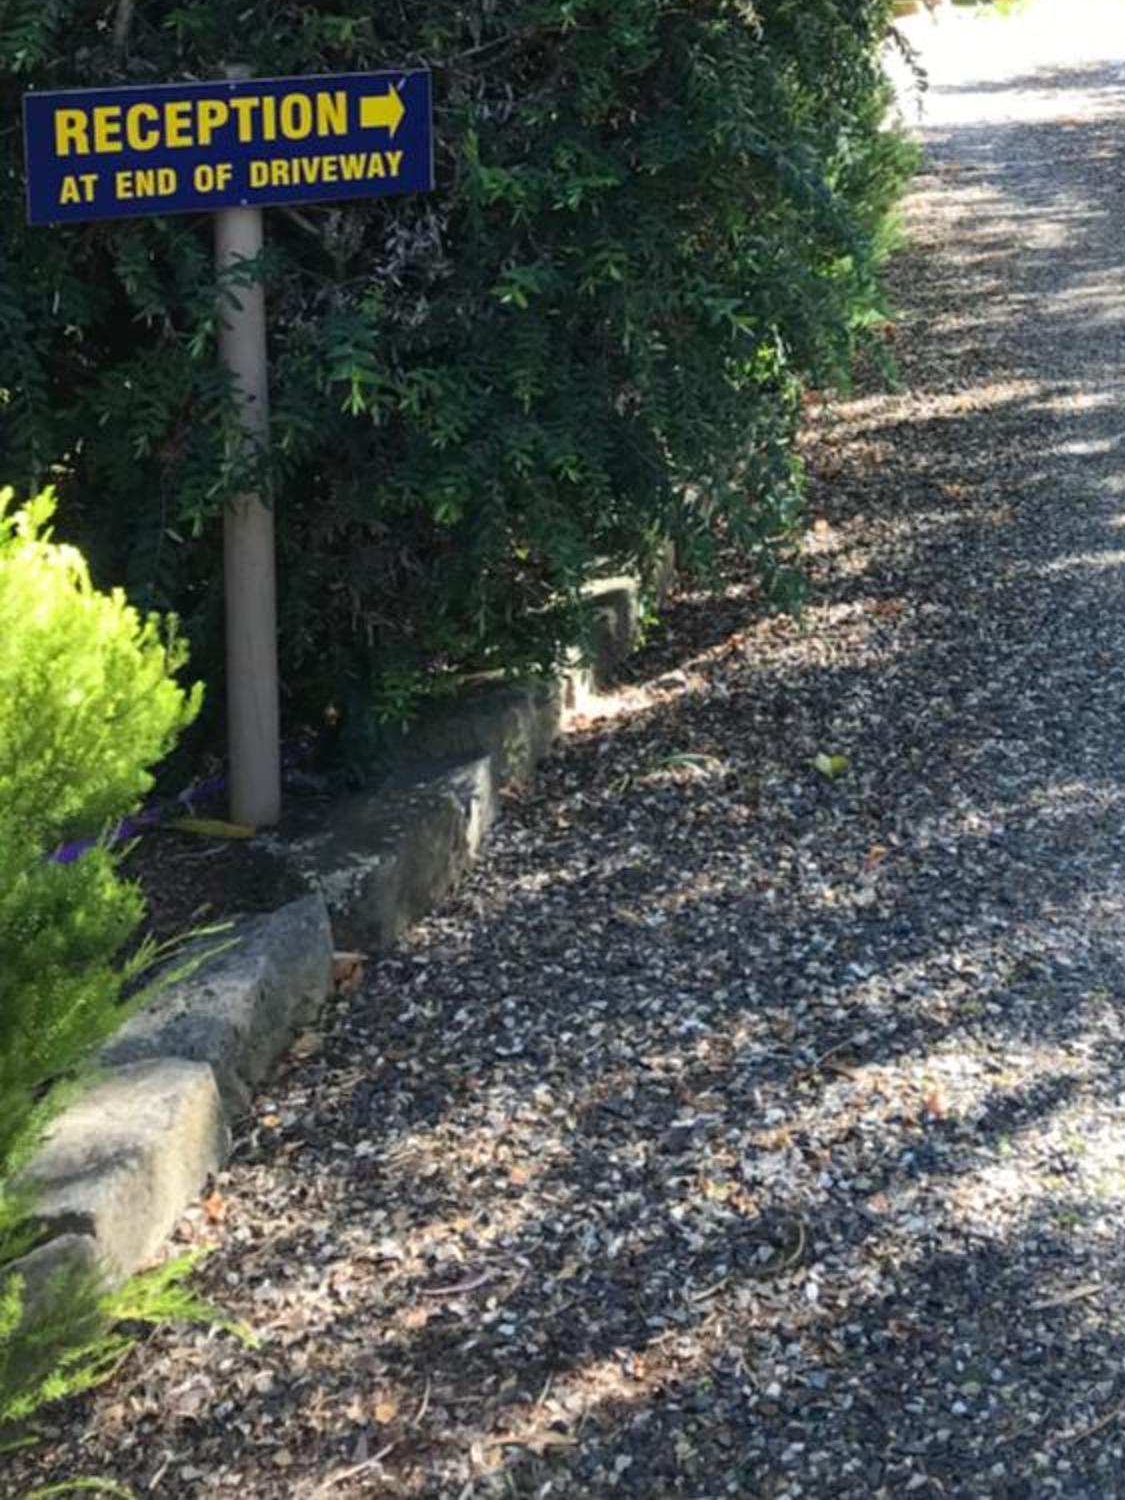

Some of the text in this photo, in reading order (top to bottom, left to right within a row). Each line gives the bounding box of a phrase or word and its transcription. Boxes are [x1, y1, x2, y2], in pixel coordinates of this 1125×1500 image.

[54, 91, 349, 157] RECEPTION
[59, 151, 403, 204] AT END OF DRIVEWAY
